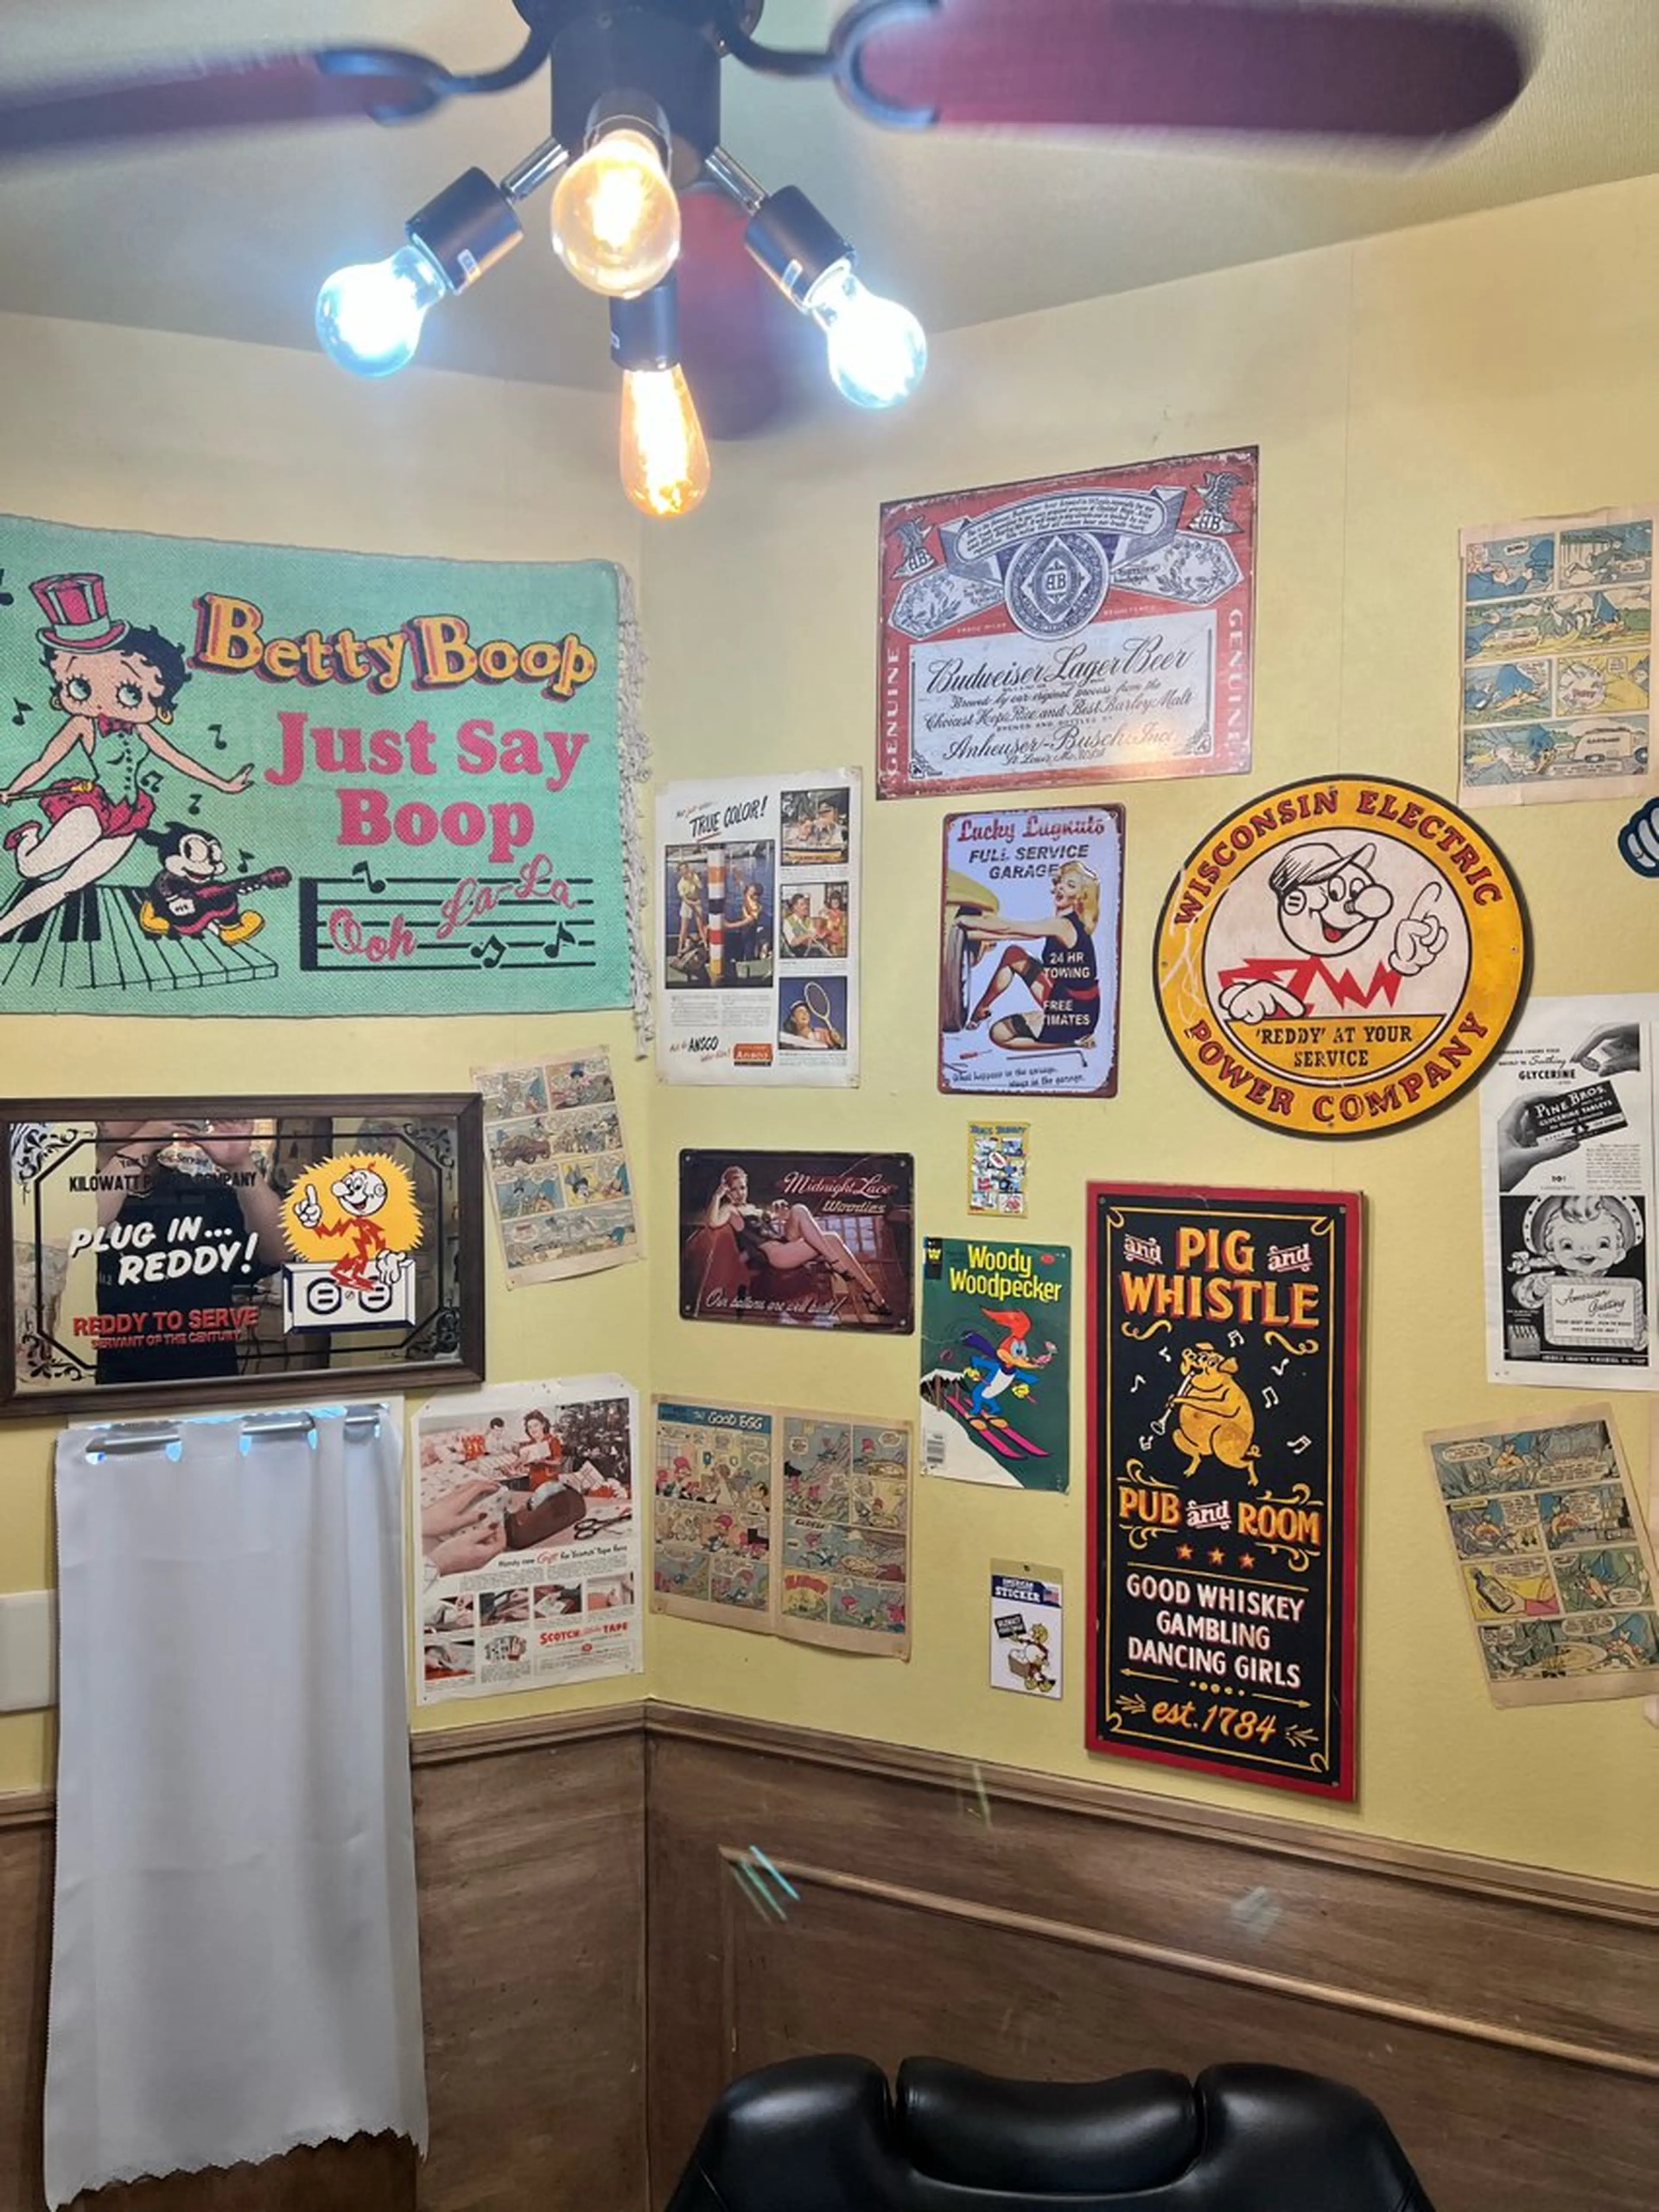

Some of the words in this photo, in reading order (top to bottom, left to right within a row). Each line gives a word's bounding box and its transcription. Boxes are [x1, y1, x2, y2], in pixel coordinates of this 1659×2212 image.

[187, 592, 408, 694] Betty
[410, 613, 597, 702] Boop
[926, 658, 1043, 693] Budweiser
[1044, 643, 1123, 685] Lager
[1122, 635, 1193, 676] Beer
[264, 712, 436, 785] Just
[457, 720, 590, 791] Say
[335, 788, 535, 862] Boop
[689, 811, 721, 838] TRUE
[723, 795, 768, 828] COLOR!
[957, 819, 1016, 845] Lucky
[1022, 815, 1105, 842] Lugnuts
[969, 847, 1009, 864] FULL
[1014, 844, 1090, 861] SERVICE
[988, 863, 1059, 880] GARAGE
[1174, 787, 1339, 925] WISCONSIN
[1357, 790, 1504, 908] ELECTRIC
[328, 908, 417, 963] Ooh
[1043, 966, 1091, 979] TOWING
[1049, 952, 1065, 964] 24
[1067, 951, 1085, 963] HR
[1043, 999, 1074, 1011] FREE
[1334, 1027, 1356, 1042] AT
[1363, 1025, 1413, 1042] YOUR
[1185, 1018, 1296, 1116] POWER
[1312, 1011, 1489, 1123] COMPANY
[1293, 1049, 1369, 1068] SERVICE
[1534, 1100, 1570, 1119] PINE
[69, 1173, 140, 1192] KILOWATT
[783, 1170, 856, 1199] Midnight
[852, 1173, 895, 1199] Lace
[68, 1220, 156, 1259] PLUG
[166, 1214, 234, 1245] IN...
[1123, 1236, 1163, 1265] and
[1175, 1226, 1255, 1274] PIG
[1267, 1243, 1313, 1271] and
[117, 1230, 259, 1287] REDDY!
[967, 1243, 1033, 1278] Woody
[949, 1267, 1062, 1303] Woodpecker
[1120, 1270, 1320, 1329] WHISTLE
[72, 1311, 149, 1337] REDDY
[153, 1310, 184, 1332] TO
[188, 1305, 260, 1329] SERVE
[91, 1334, 145, 1351] SERVANT
[145, 1334, 164, 1347] OF
[163, 1332, 188, 1345] THE
[188, 1328, 242, 1344] CENTURY
[707, 1411, 736, 1427] GOOD
[1118, 1485, 1182, 1526] PUB
[1186, 1500, 1232, 1529] and
[1238, 1501, 1321, 1545] ROOM
[994, 1586, 1041, 1603] STICKER
[1125, 1573, 1191, 1604] GOOD
[1197, 1583, 1305, 1622] WHISKEY
[539, 1629, 580, 1646] SCOTCH
[603, 1621, 629, 1634] TAPE
[1156, 1609, 1271, 1651] GAMBLING
[1127, 1636, 1227, 1676] DANCING
[1234, 1655, 1302, 1689] GIRLS
